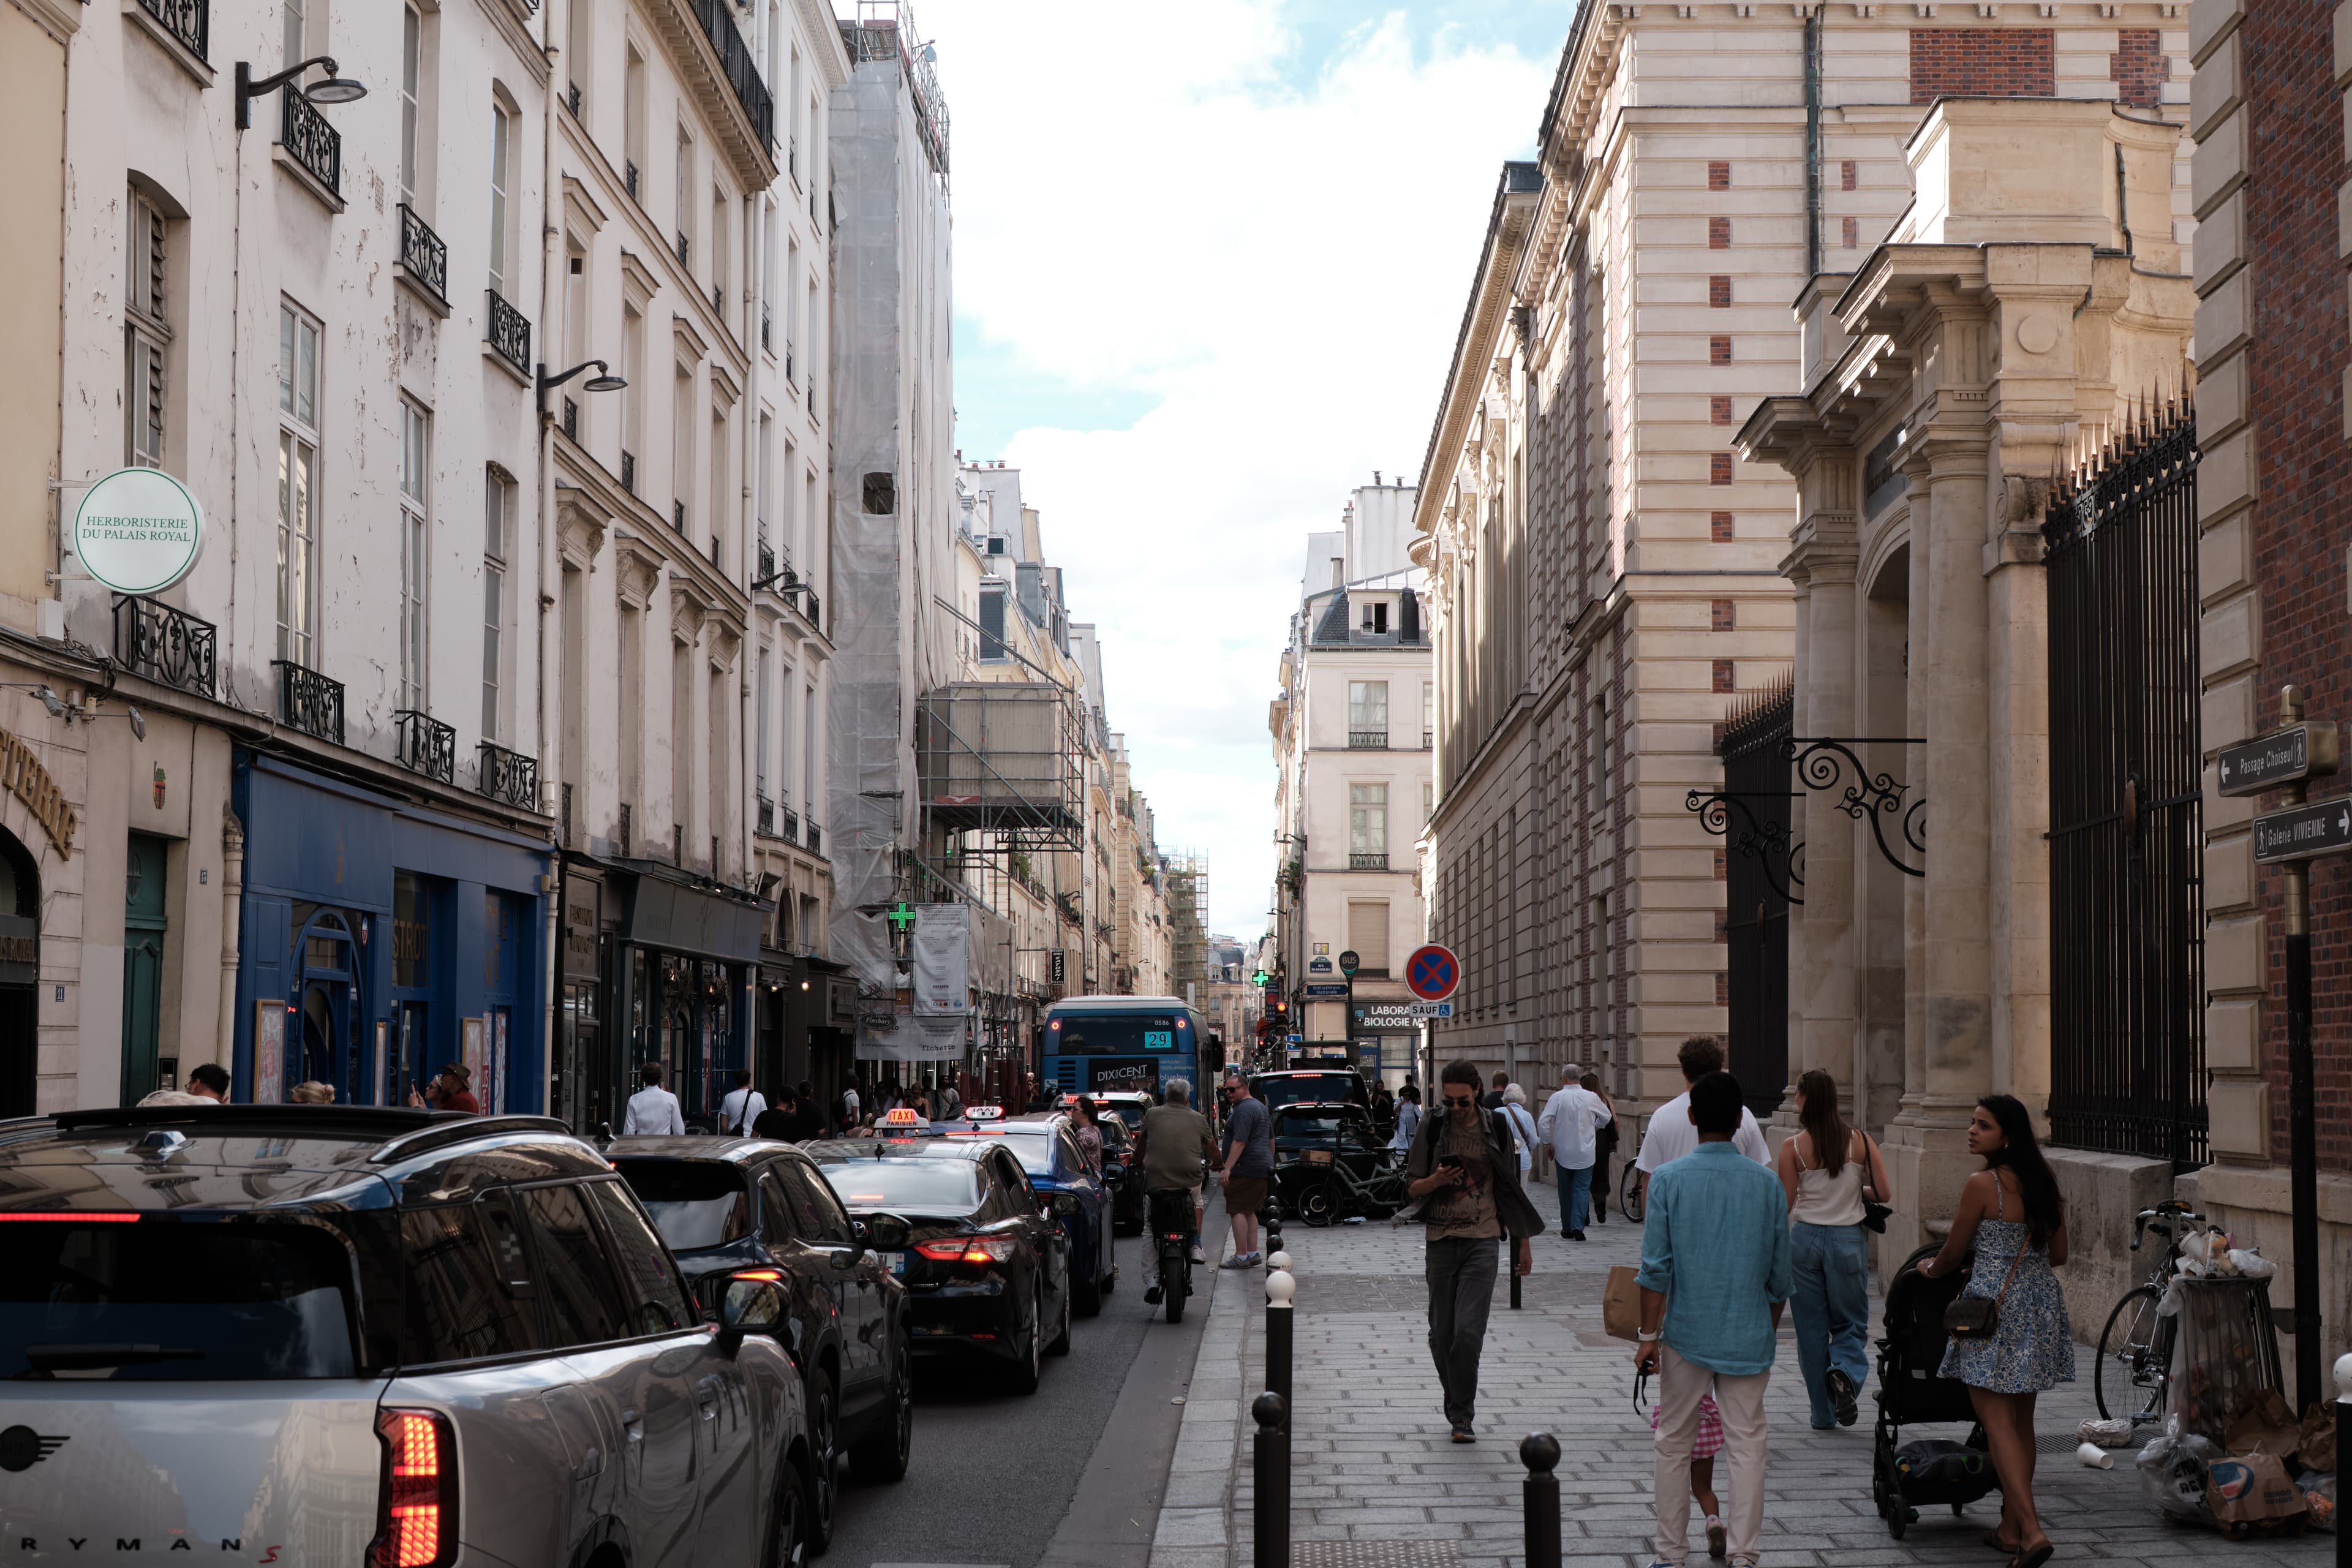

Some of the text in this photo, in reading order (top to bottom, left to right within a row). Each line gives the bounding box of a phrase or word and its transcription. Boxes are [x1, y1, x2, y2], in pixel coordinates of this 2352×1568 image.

[86, 516, 187, 529] HERBORISTERIE
[83, 529, 190, 541] DU PALAIS ROYAL
[2240, 744, 2293, 775] Passage Choiseul
[2267, 817, 2326, 846] Galerie VIVIENNE
[58, 987, 64, 1000] 11
[866, 1017, 891, 1025] Finsbury
[1363, 1017, 1409, 1027] BIOLOGIE
[1149, 1033, 1167, 1046] 29
[1098, 1069, 1115, 1082] DIX
[1118, 1065, 1147, 1078] CENT
[891, 1111, 913, 1120] TAXI
[21, 1537, 282, 1564] RYMAN S
